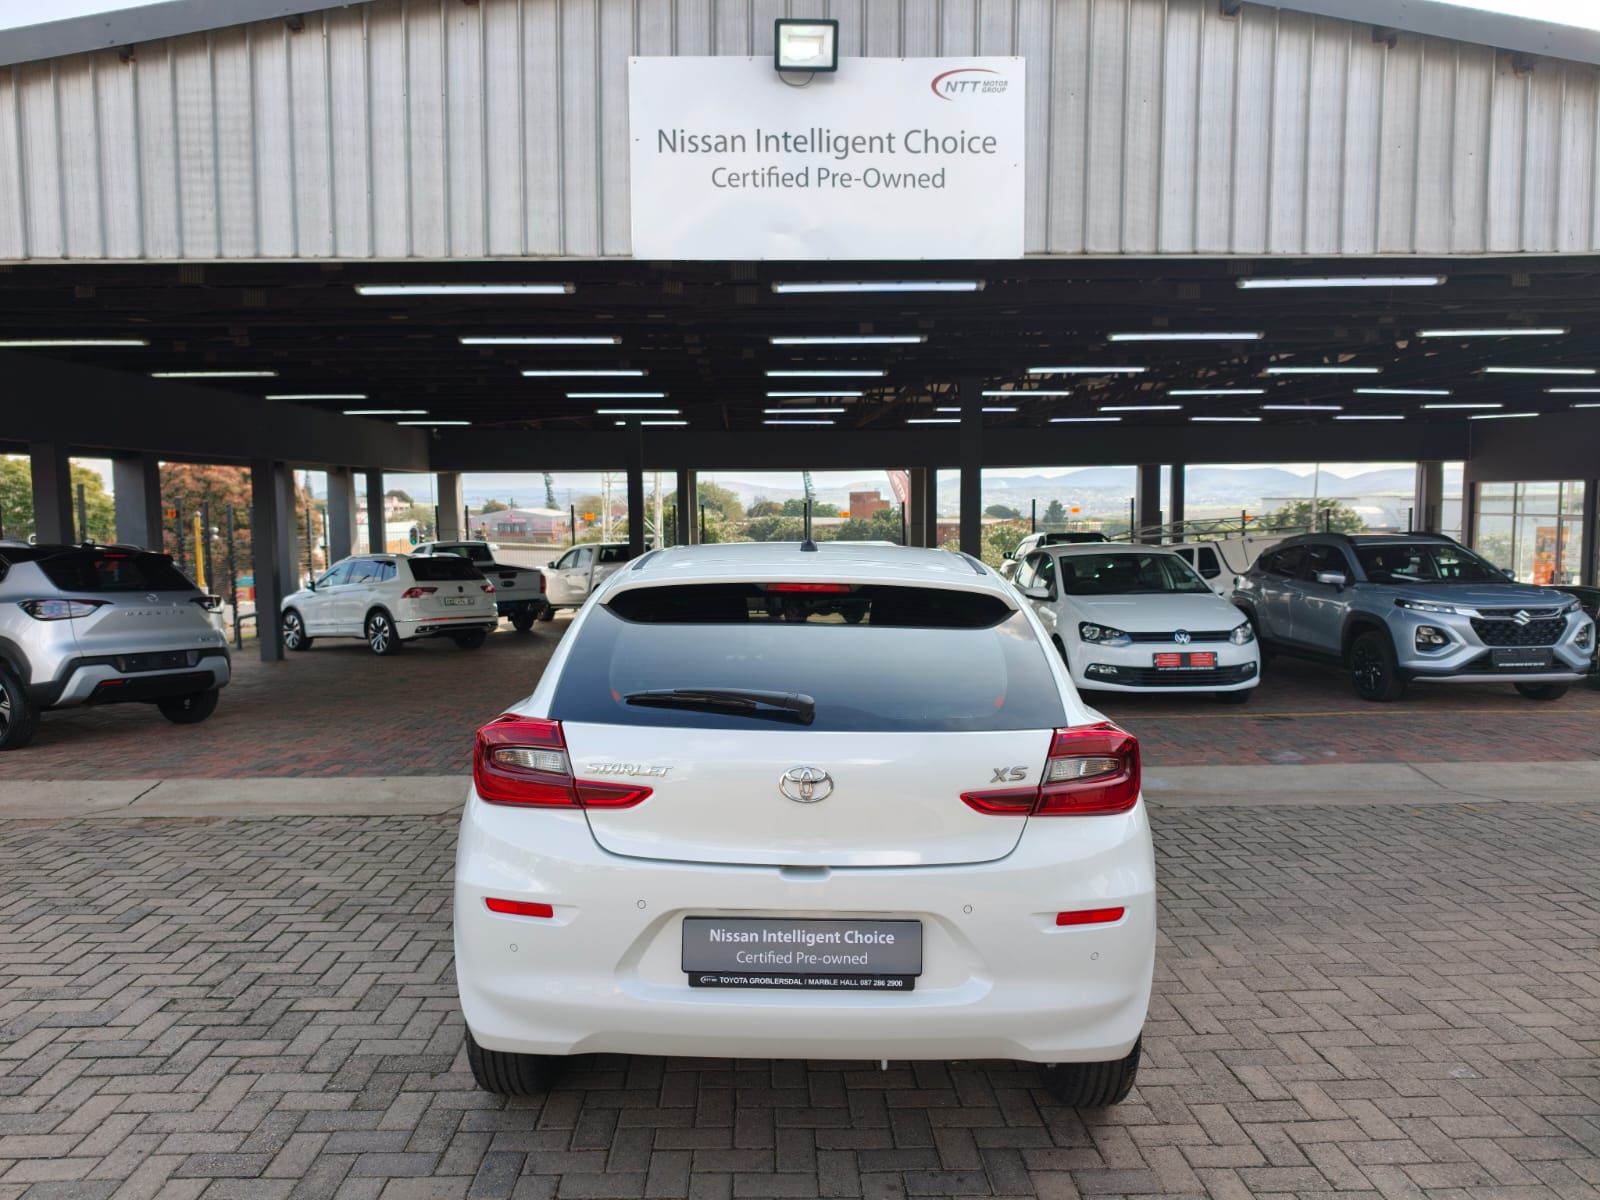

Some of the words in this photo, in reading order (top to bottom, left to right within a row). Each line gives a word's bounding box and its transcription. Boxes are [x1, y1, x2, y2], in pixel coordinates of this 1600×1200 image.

[945, 80, 982, 93] NTT
[657, 128, 747, 154] Nissan
[755, 127, 896, 160] Intelligent
[903, 128, 997, 155] Choice
[711, 166, 810, 189] Certified
[817, 167, 946, 189] Pre-Owned
[584, 763, 674, 778] STARLET
[990, 766, 1029, 783] XS
[709, 928, 758, 943] Nissan
[762, 929, 841, 946] Intelligent
[844, 930, 896, 945] Choice
[735, 951, 793, 965] Certified
[796, 952, 868, 966] Pre-owned
[719, 976, 748, 984] TOYOTA
[749, 977, 803, 985] GROBLERSDAL
[808, 978, 839, 986] MARBLE
